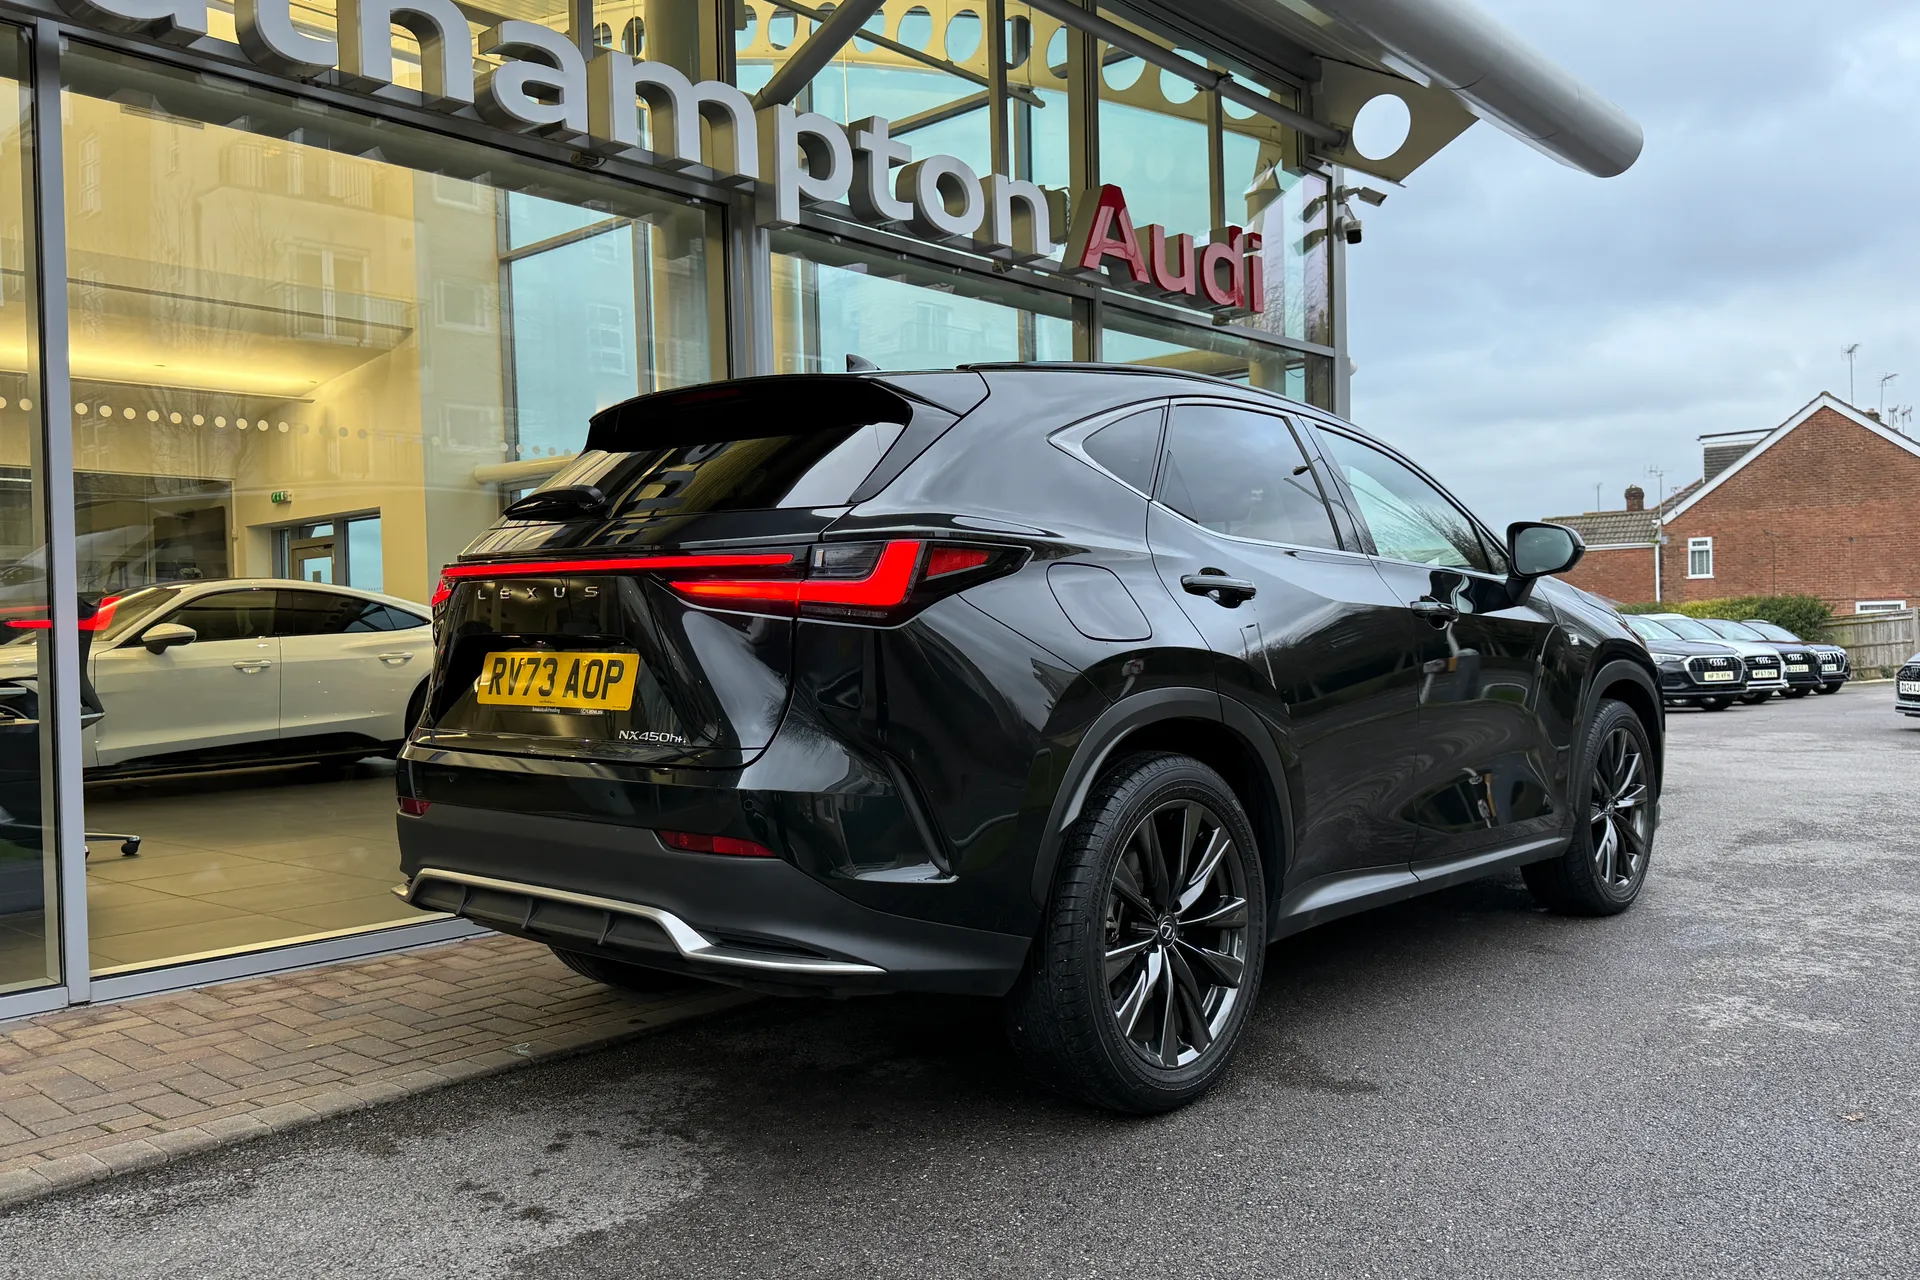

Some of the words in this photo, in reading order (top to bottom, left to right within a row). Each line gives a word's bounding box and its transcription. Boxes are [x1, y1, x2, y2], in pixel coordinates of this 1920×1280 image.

[1074, 183, 1264, 314] Audi
[477, 586, 600, 600] LEXUS
[487, 657, 559, 697] RV73
[562, 658, 625, 701] AOP
[618, 729, 683, 744] NX450h+
